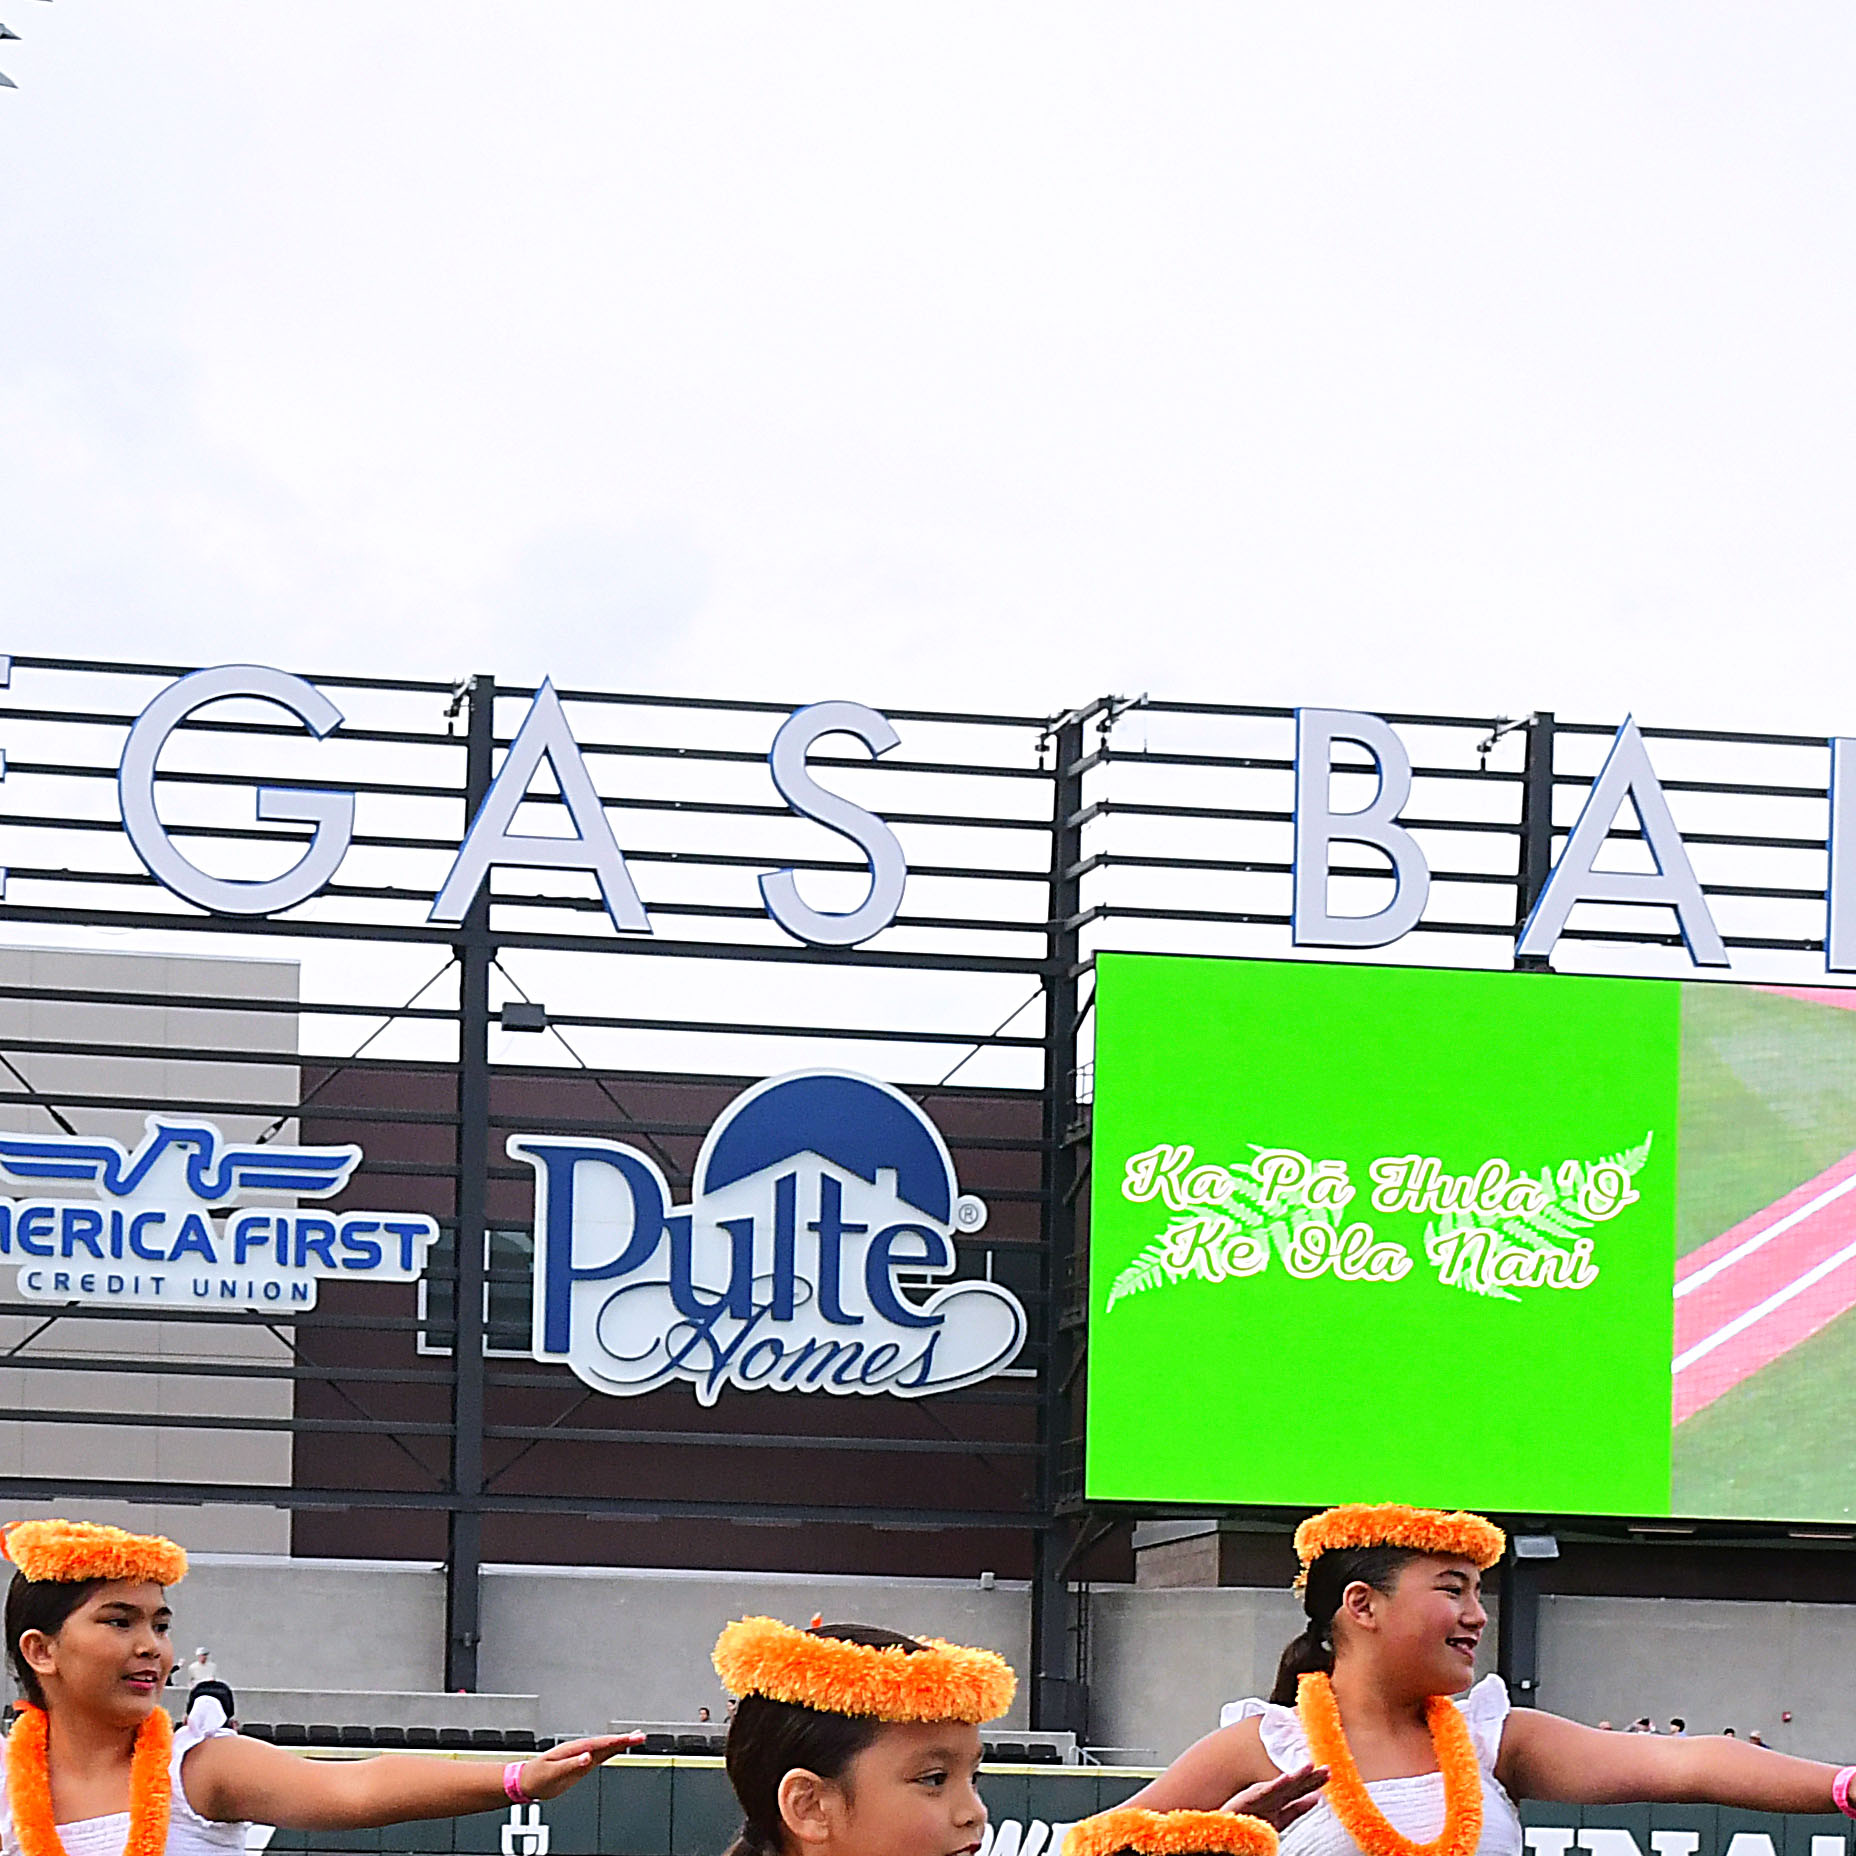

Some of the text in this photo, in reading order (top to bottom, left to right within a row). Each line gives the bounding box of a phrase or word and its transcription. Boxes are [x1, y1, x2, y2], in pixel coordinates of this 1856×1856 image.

[1121, 1144, 1235, 1211] Ka
[1369, 1154, 1546, 1218] Hula
[233, 1215, 432, 1272] FIRST
[517, 1143, 948, 1354] Pulte
[1160, 1217, 1600, 1289] Ke Ola Nani
[27, 1271, 309, 1301] CREDIT UNION
[590, 1274, 1022, 1396] Homes
